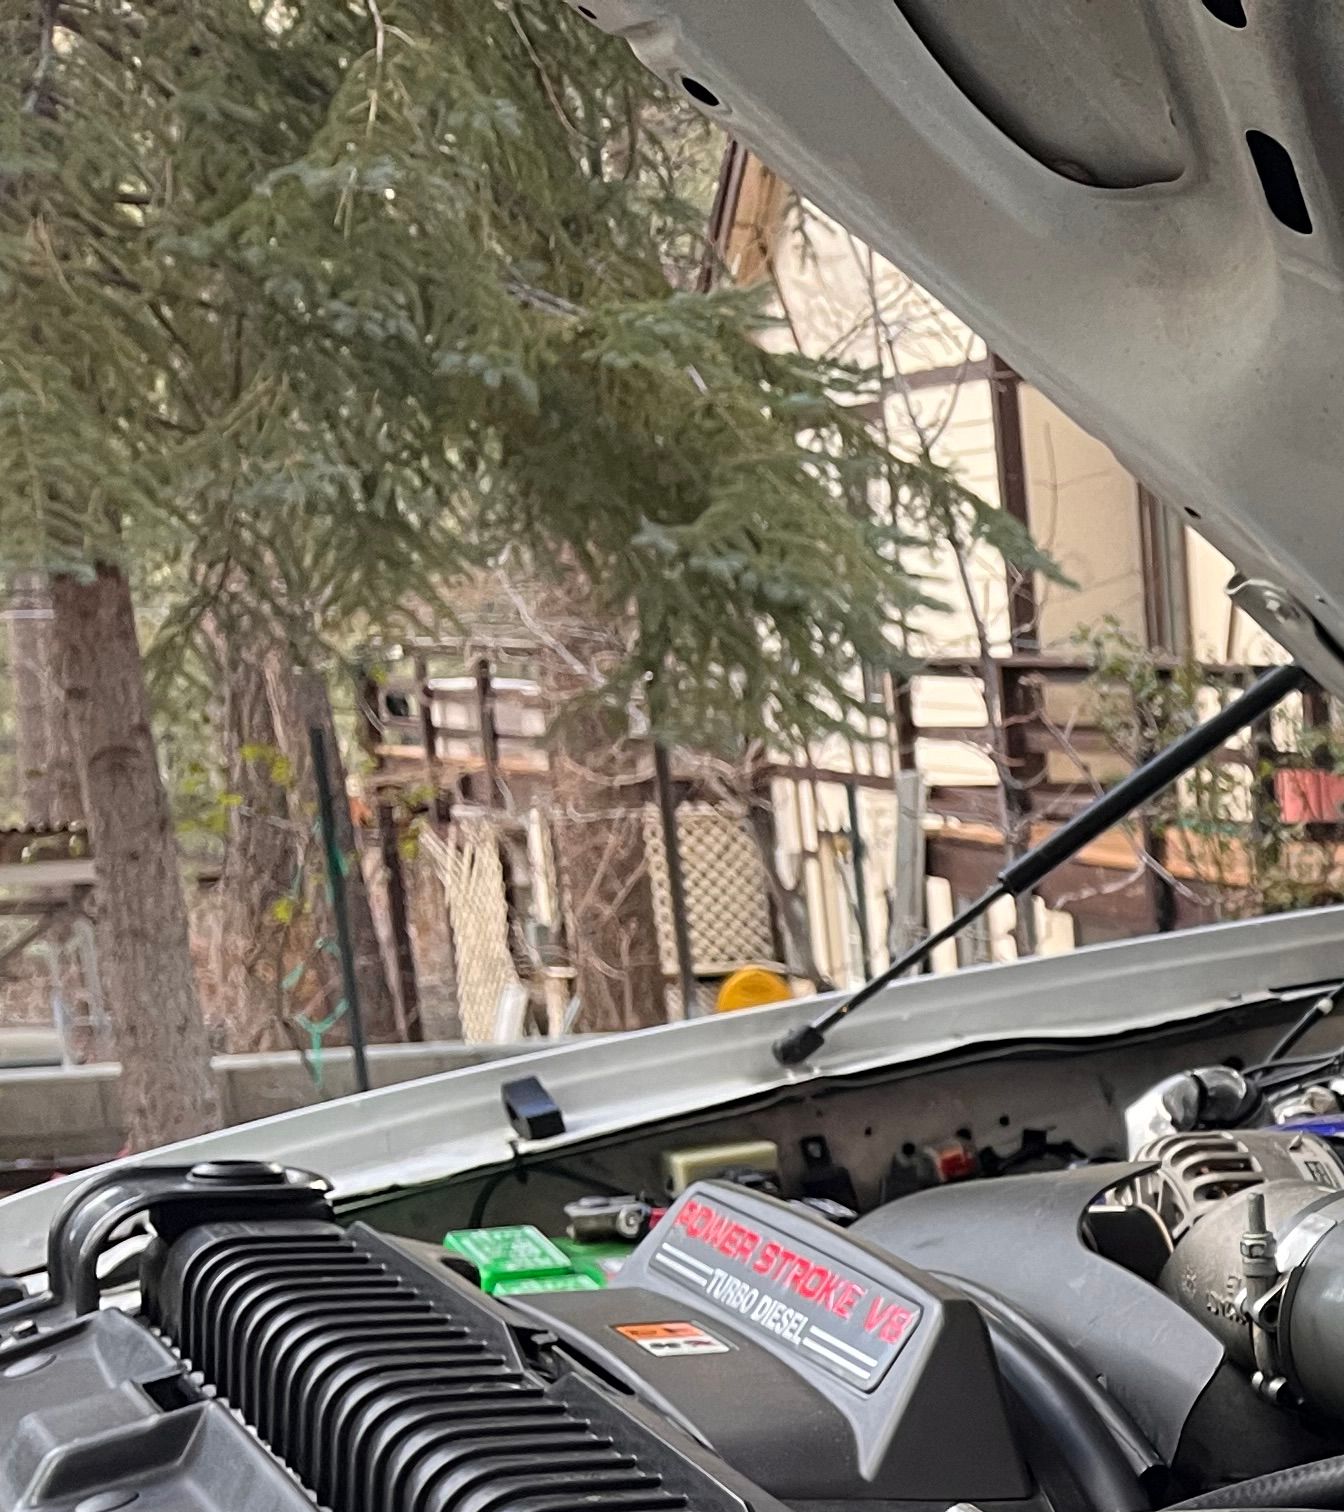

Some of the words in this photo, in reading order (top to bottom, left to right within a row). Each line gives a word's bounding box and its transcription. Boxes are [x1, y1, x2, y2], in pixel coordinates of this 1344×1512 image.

[676, 1200, 760, 1263] POWER
[753, 1242, 868, 1319] STROKE
[864, 1296, 913, 1343] V8
[706, 1269, 758, 1313] TURBO
[751, 1296, 808, 1345] DIESEL
